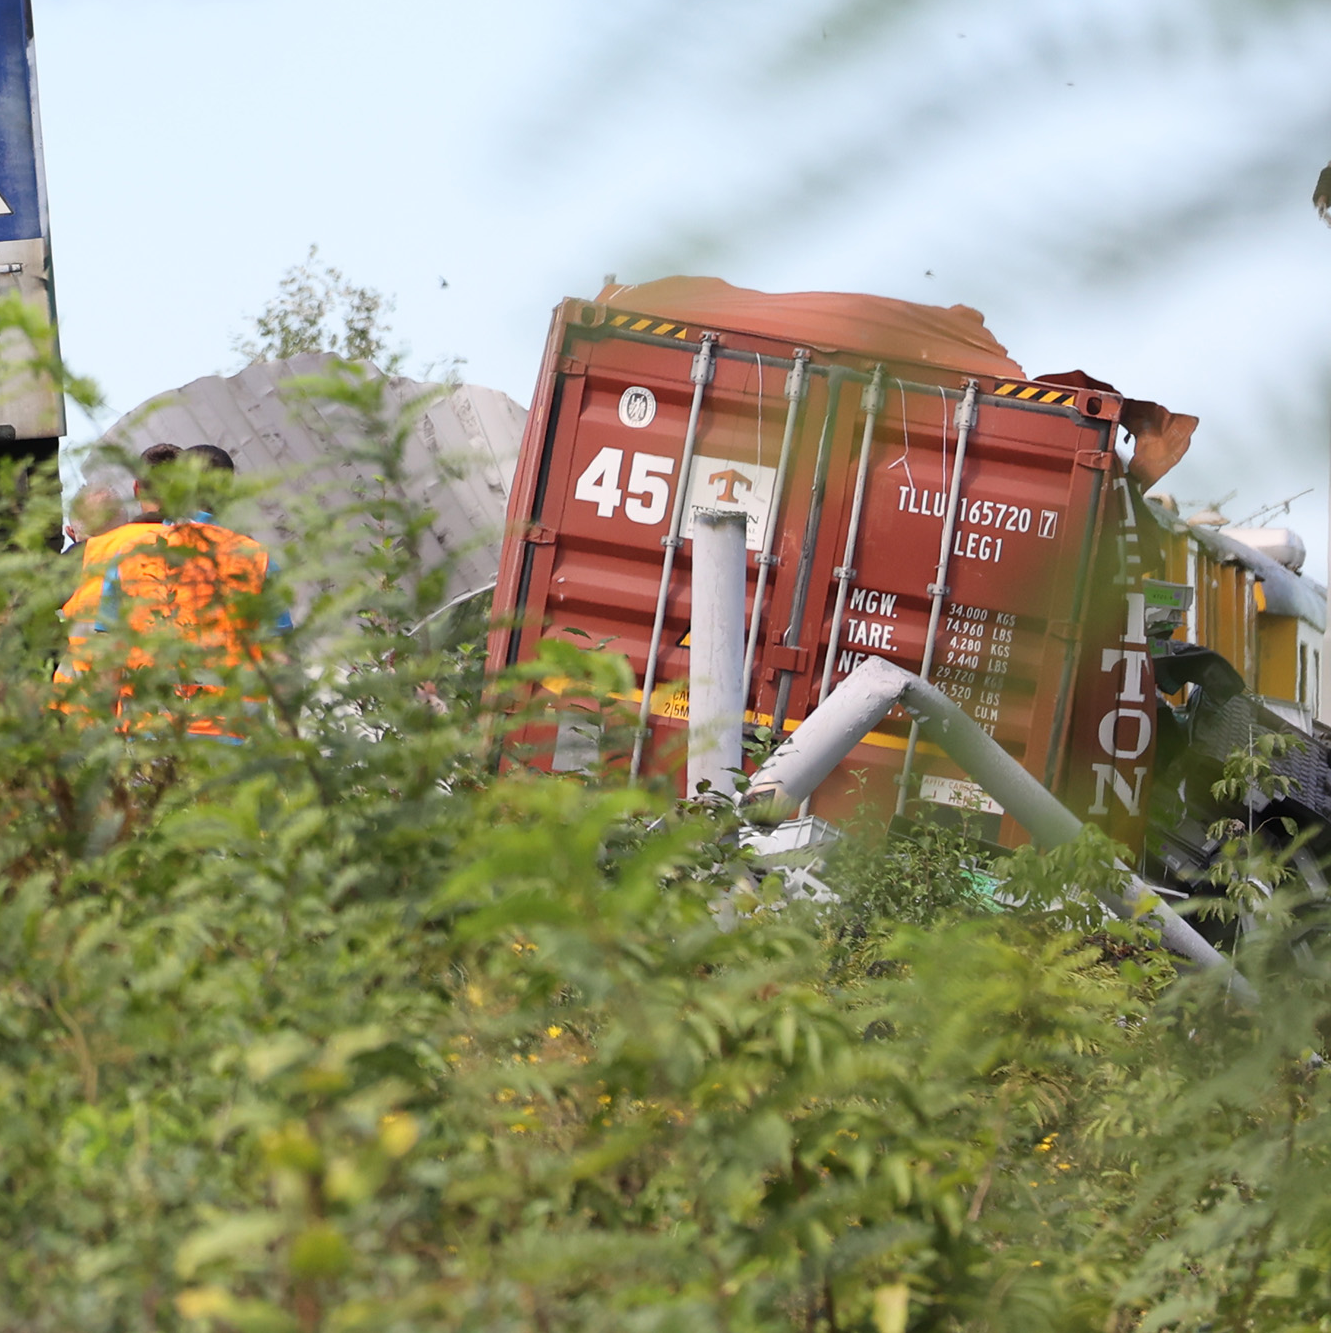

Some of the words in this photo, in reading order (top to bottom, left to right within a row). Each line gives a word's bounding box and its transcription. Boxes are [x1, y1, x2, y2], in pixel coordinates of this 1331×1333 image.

[574, 446, 675, 525] 45
[898, 486, 947, 517] TLLU
[959, 498, 1031, 533] 165720
[1041, 511, 1055, 537] 7
[953, 530, 1003, 563] LEG1
[850, 588, 898, 618] MGW.
[996, 612, 1016, 627] KGS
[847, 619, 898, 652] TARE.
[992, 628, 1013, 643] LBS
[991, 644, 1011, 658] KGS
[838, 650, 872, 673] NE
[987, 658, 1008, 674] LBS
[980, 691, 1001, 706] LBS
